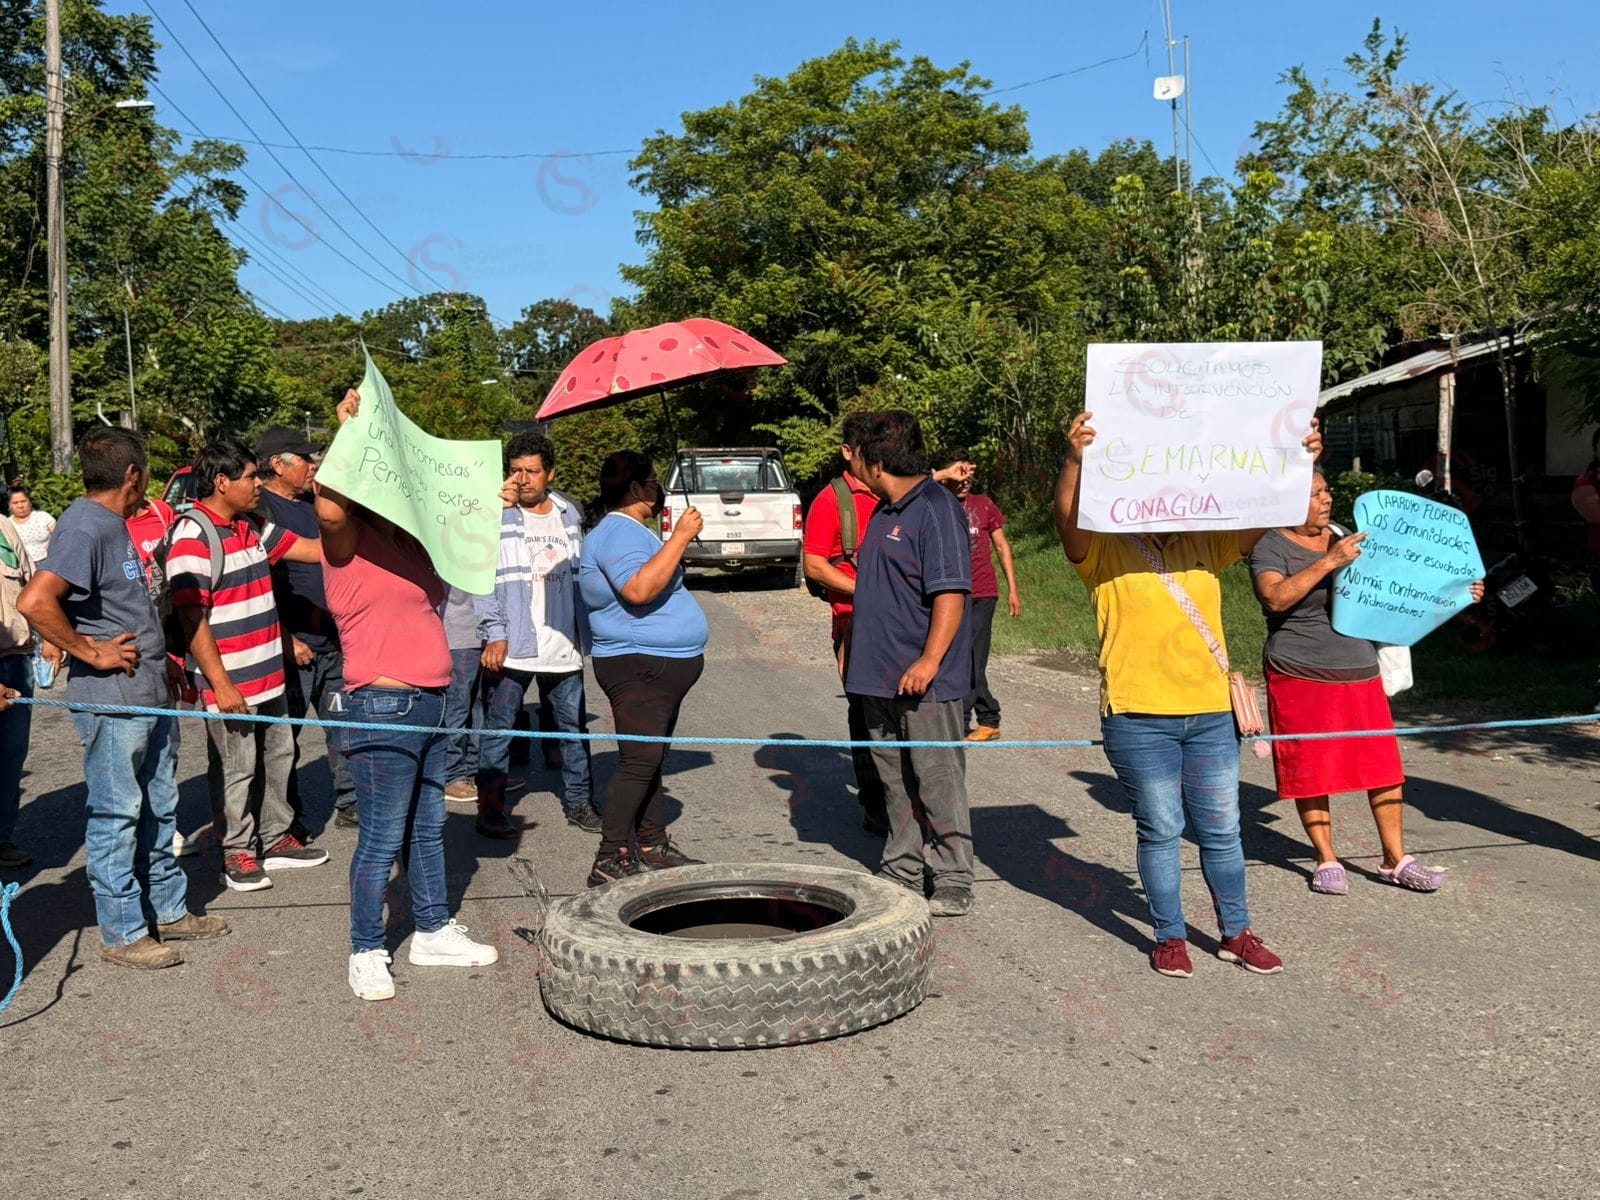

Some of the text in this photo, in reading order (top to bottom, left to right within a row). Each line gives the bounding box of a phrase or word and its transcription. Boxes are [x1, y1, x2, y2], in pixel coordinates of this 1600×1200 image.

[1108, 381, 1141, 397] LA
[1099, 438, 1303, 481] SEMARNAT
[438, 489, 482, 516] exige
[1110, 493, 1222, 524] CONAGUA
[1362, 503, 1389, 531] Las
[1404, 549, 1422, 563] ser
[1334, 585, 1351, 600] de
